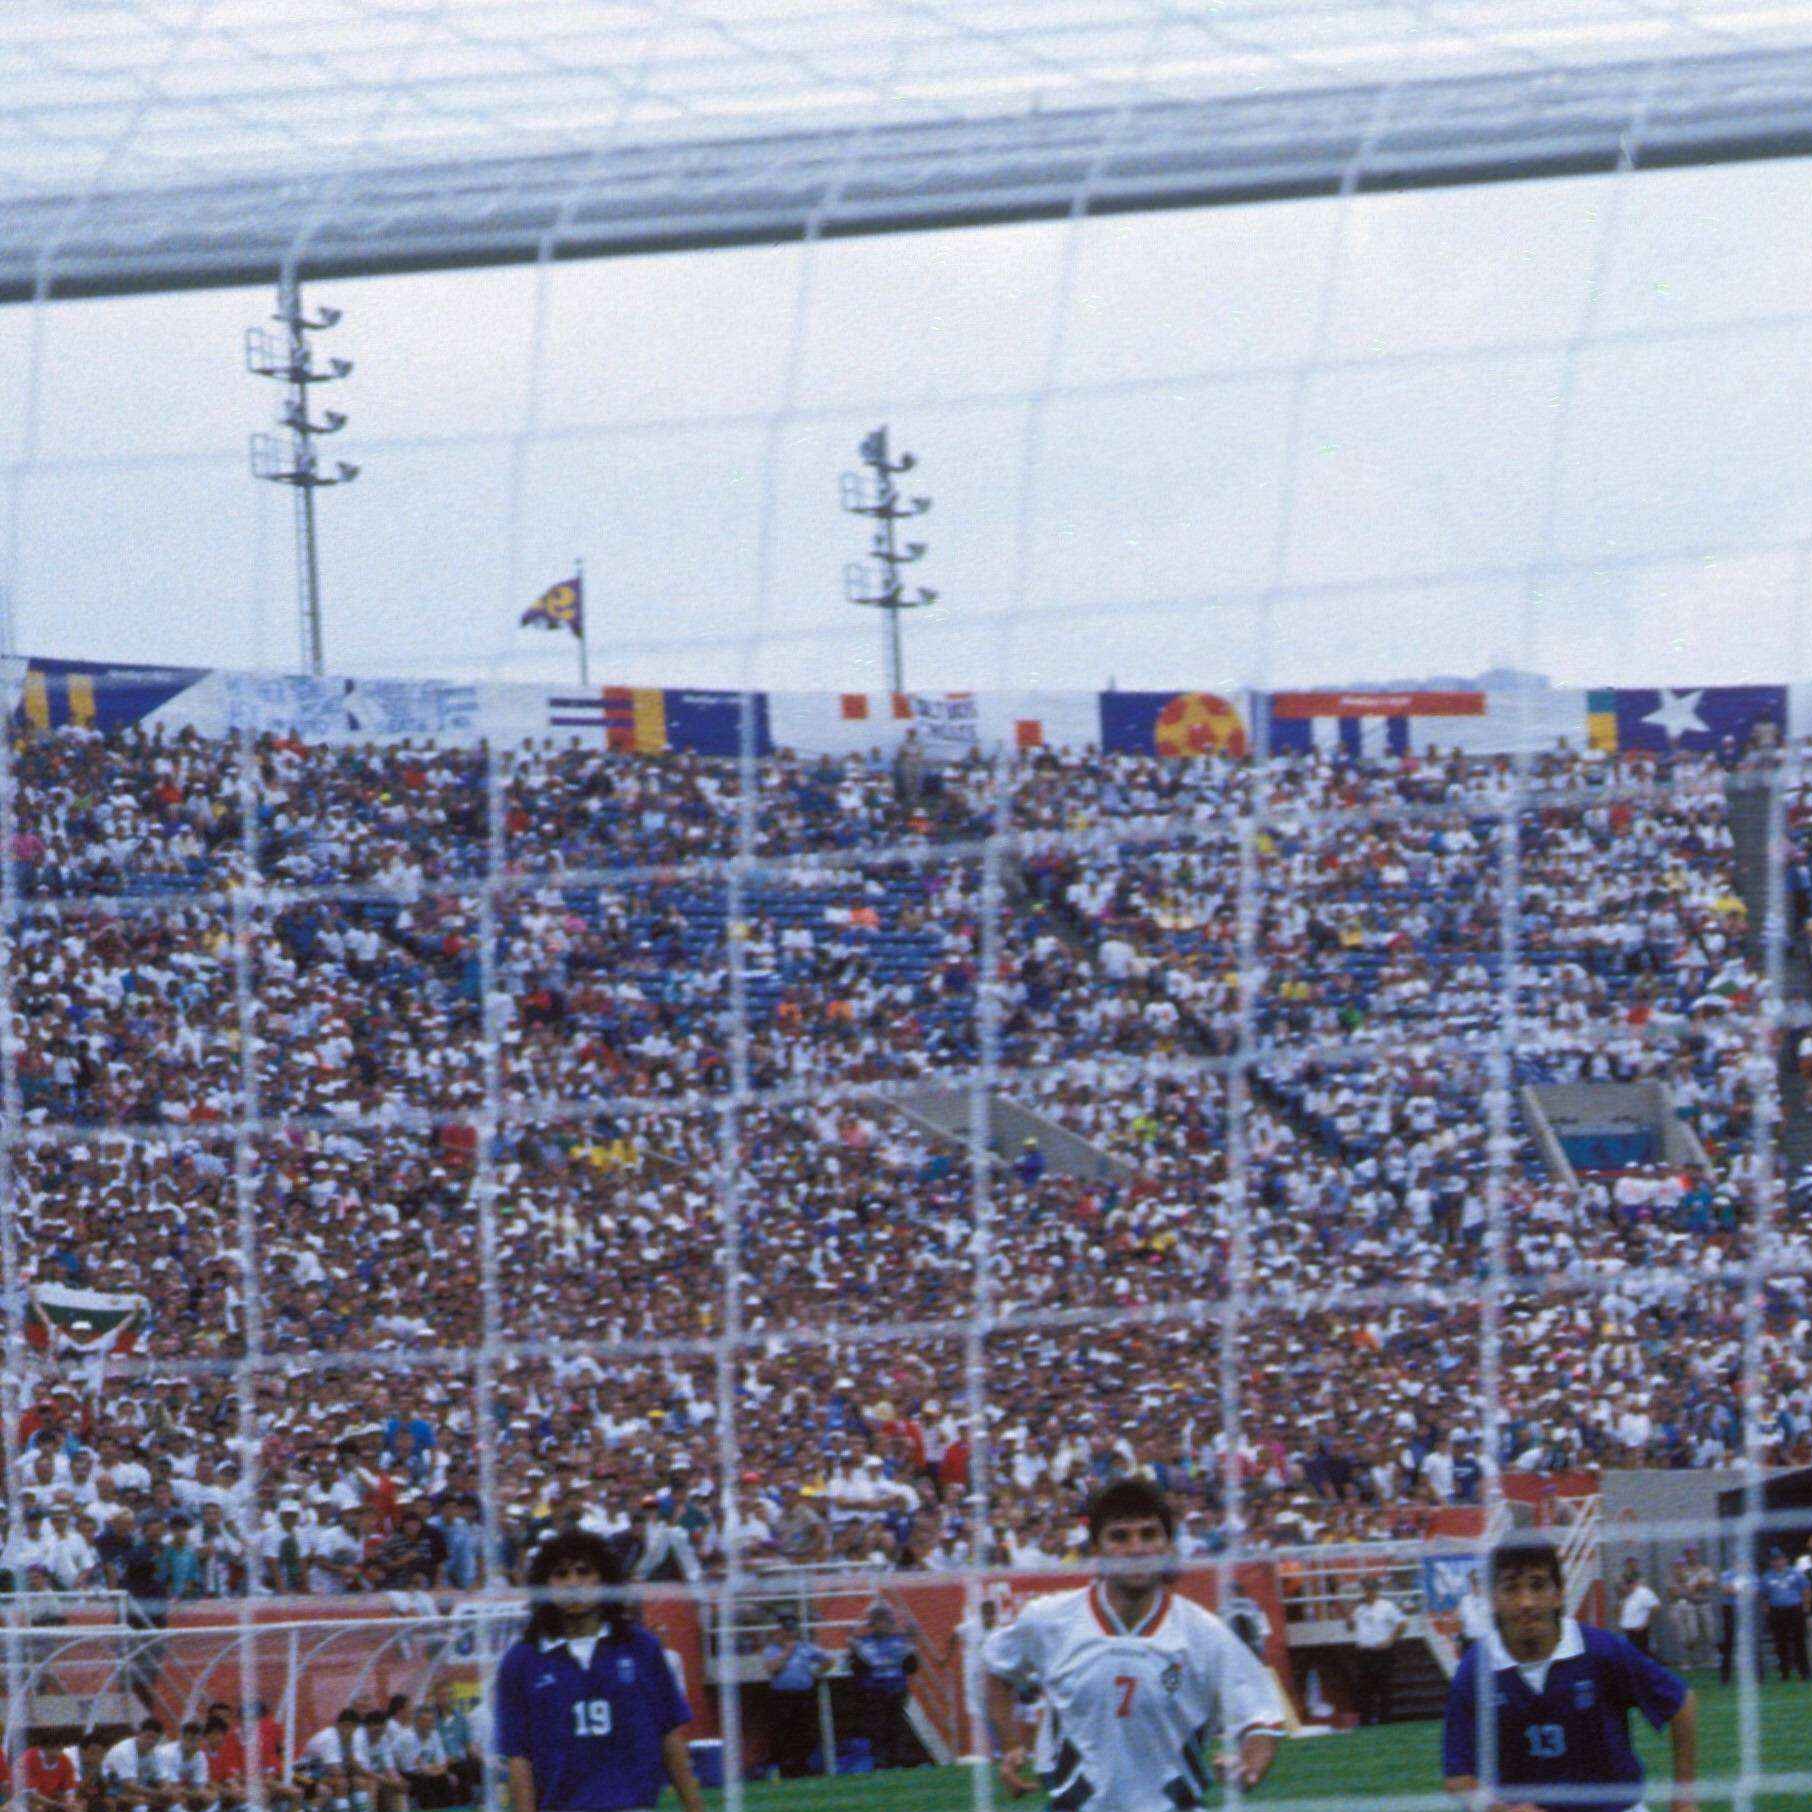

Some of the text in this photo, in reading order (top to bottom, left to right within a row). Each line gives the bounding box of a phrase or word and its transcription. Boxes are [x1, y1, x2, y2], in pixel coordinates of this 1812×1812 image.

[1114, 1675, 1138, 1718] 7
[573, 1698, 614, 1737] 19
[1523, 1723, 1568, 1759] 13
